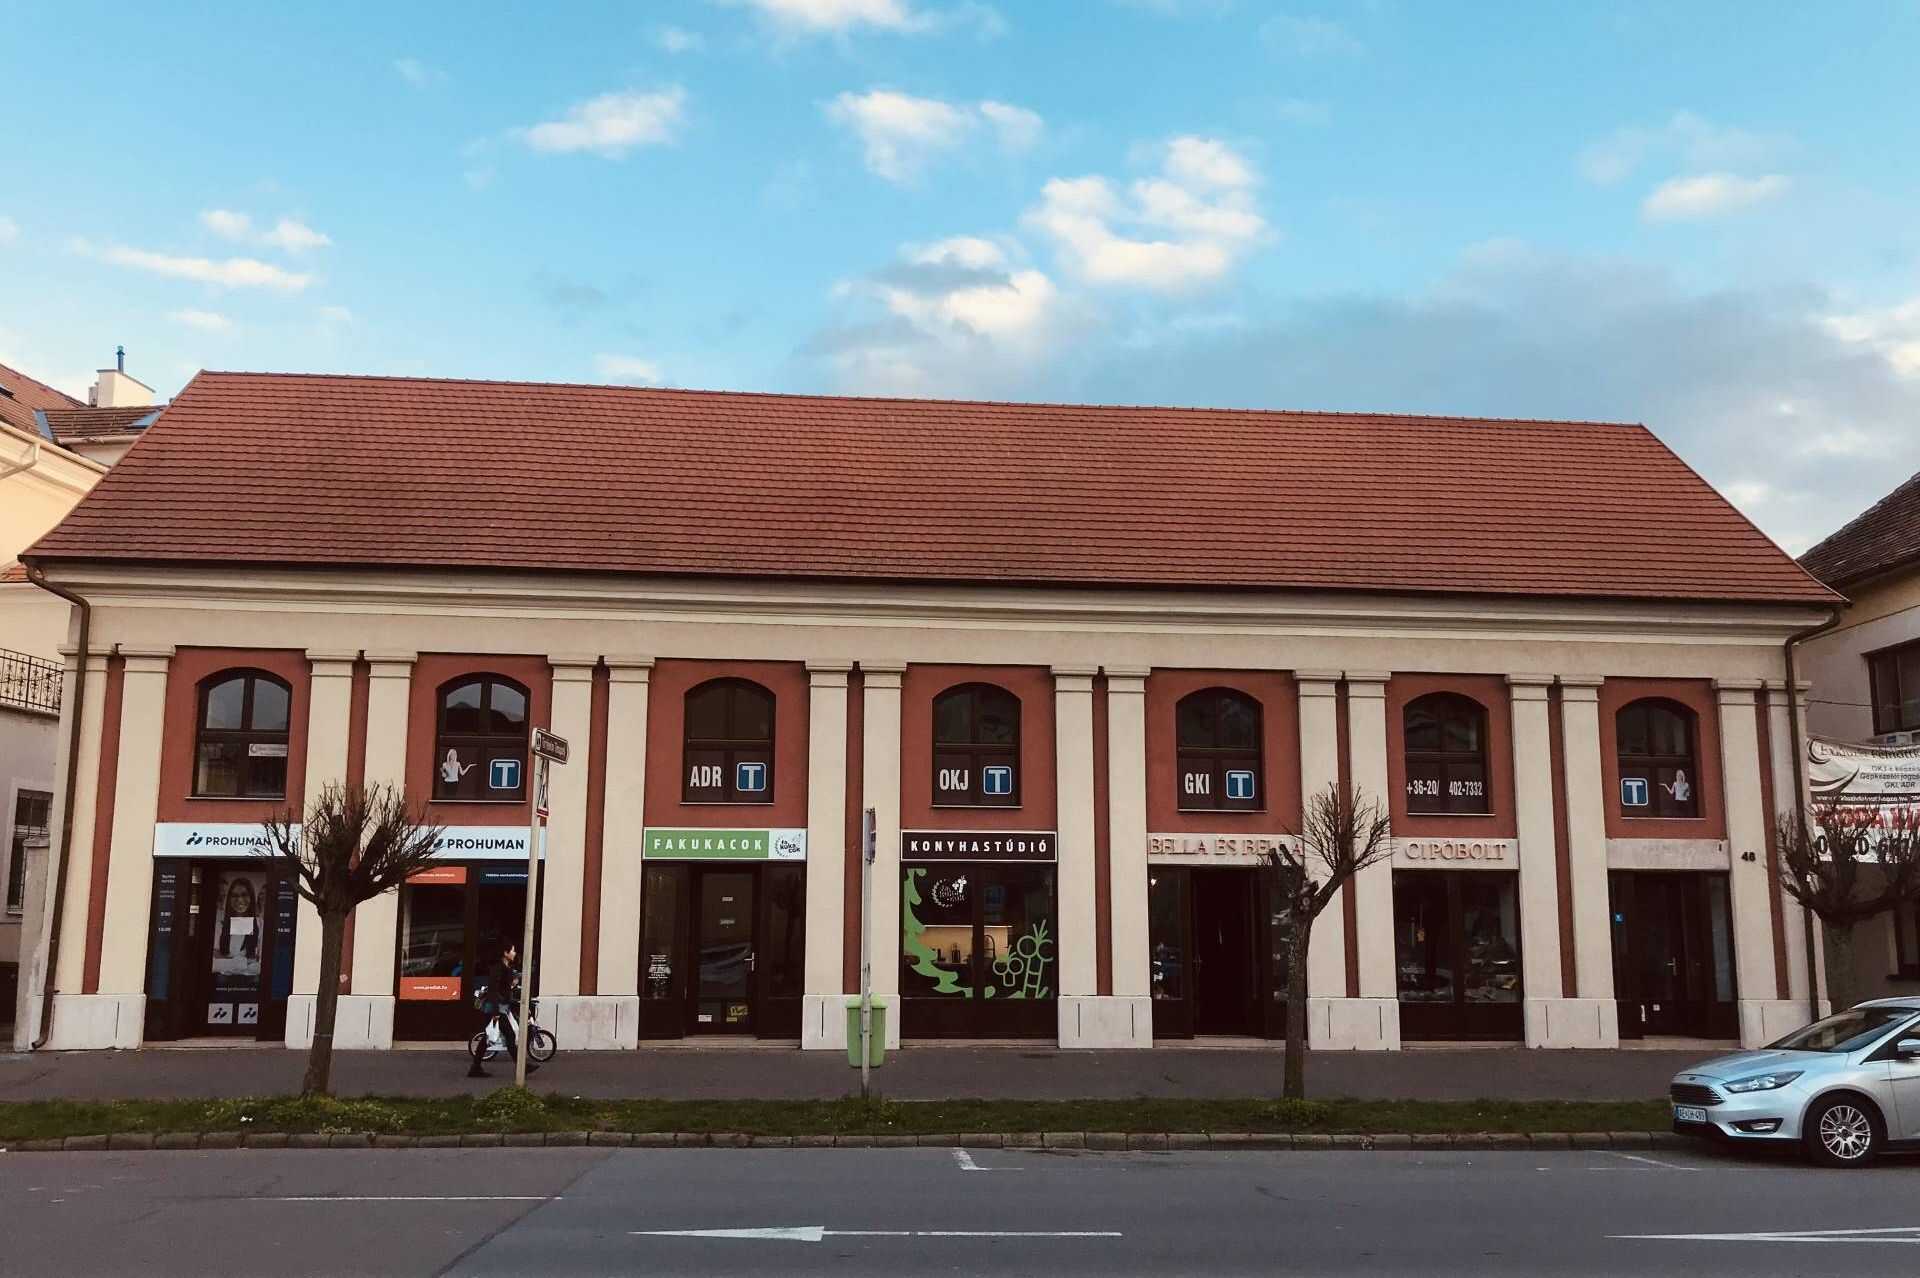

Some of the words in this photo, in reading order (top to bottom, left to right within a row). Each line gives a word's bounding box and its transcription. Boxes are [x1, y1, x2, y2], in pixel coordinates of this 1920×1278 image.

[495, 762, 515, 787] T
[690, 766, 722, 787] ADR
[742, 765, 761, 789] T
[940, 769, 969, 791] OKJ
[988, 769, 1007, 793] T
[1184, 772, 1210, 795] GKI
[1230, 773, 1249, 797] T
[1406, 779, 1440, 796] +36-20/
[1449, 781, 1483, 796] 402-7332
[1625, 781, 1644, 804] T
[206, 836, 271, 846] PROHUMAN
[447, 838, 525, 850] PROHUMAN
[653, 838, 762, 850] FAKUKACOK
[910, 838, 1047, 852] KONYHASTÚDIÓ
[1150, 838, 1208, 855] BELLA
[1214, 835, 1237, 856] ÉS
